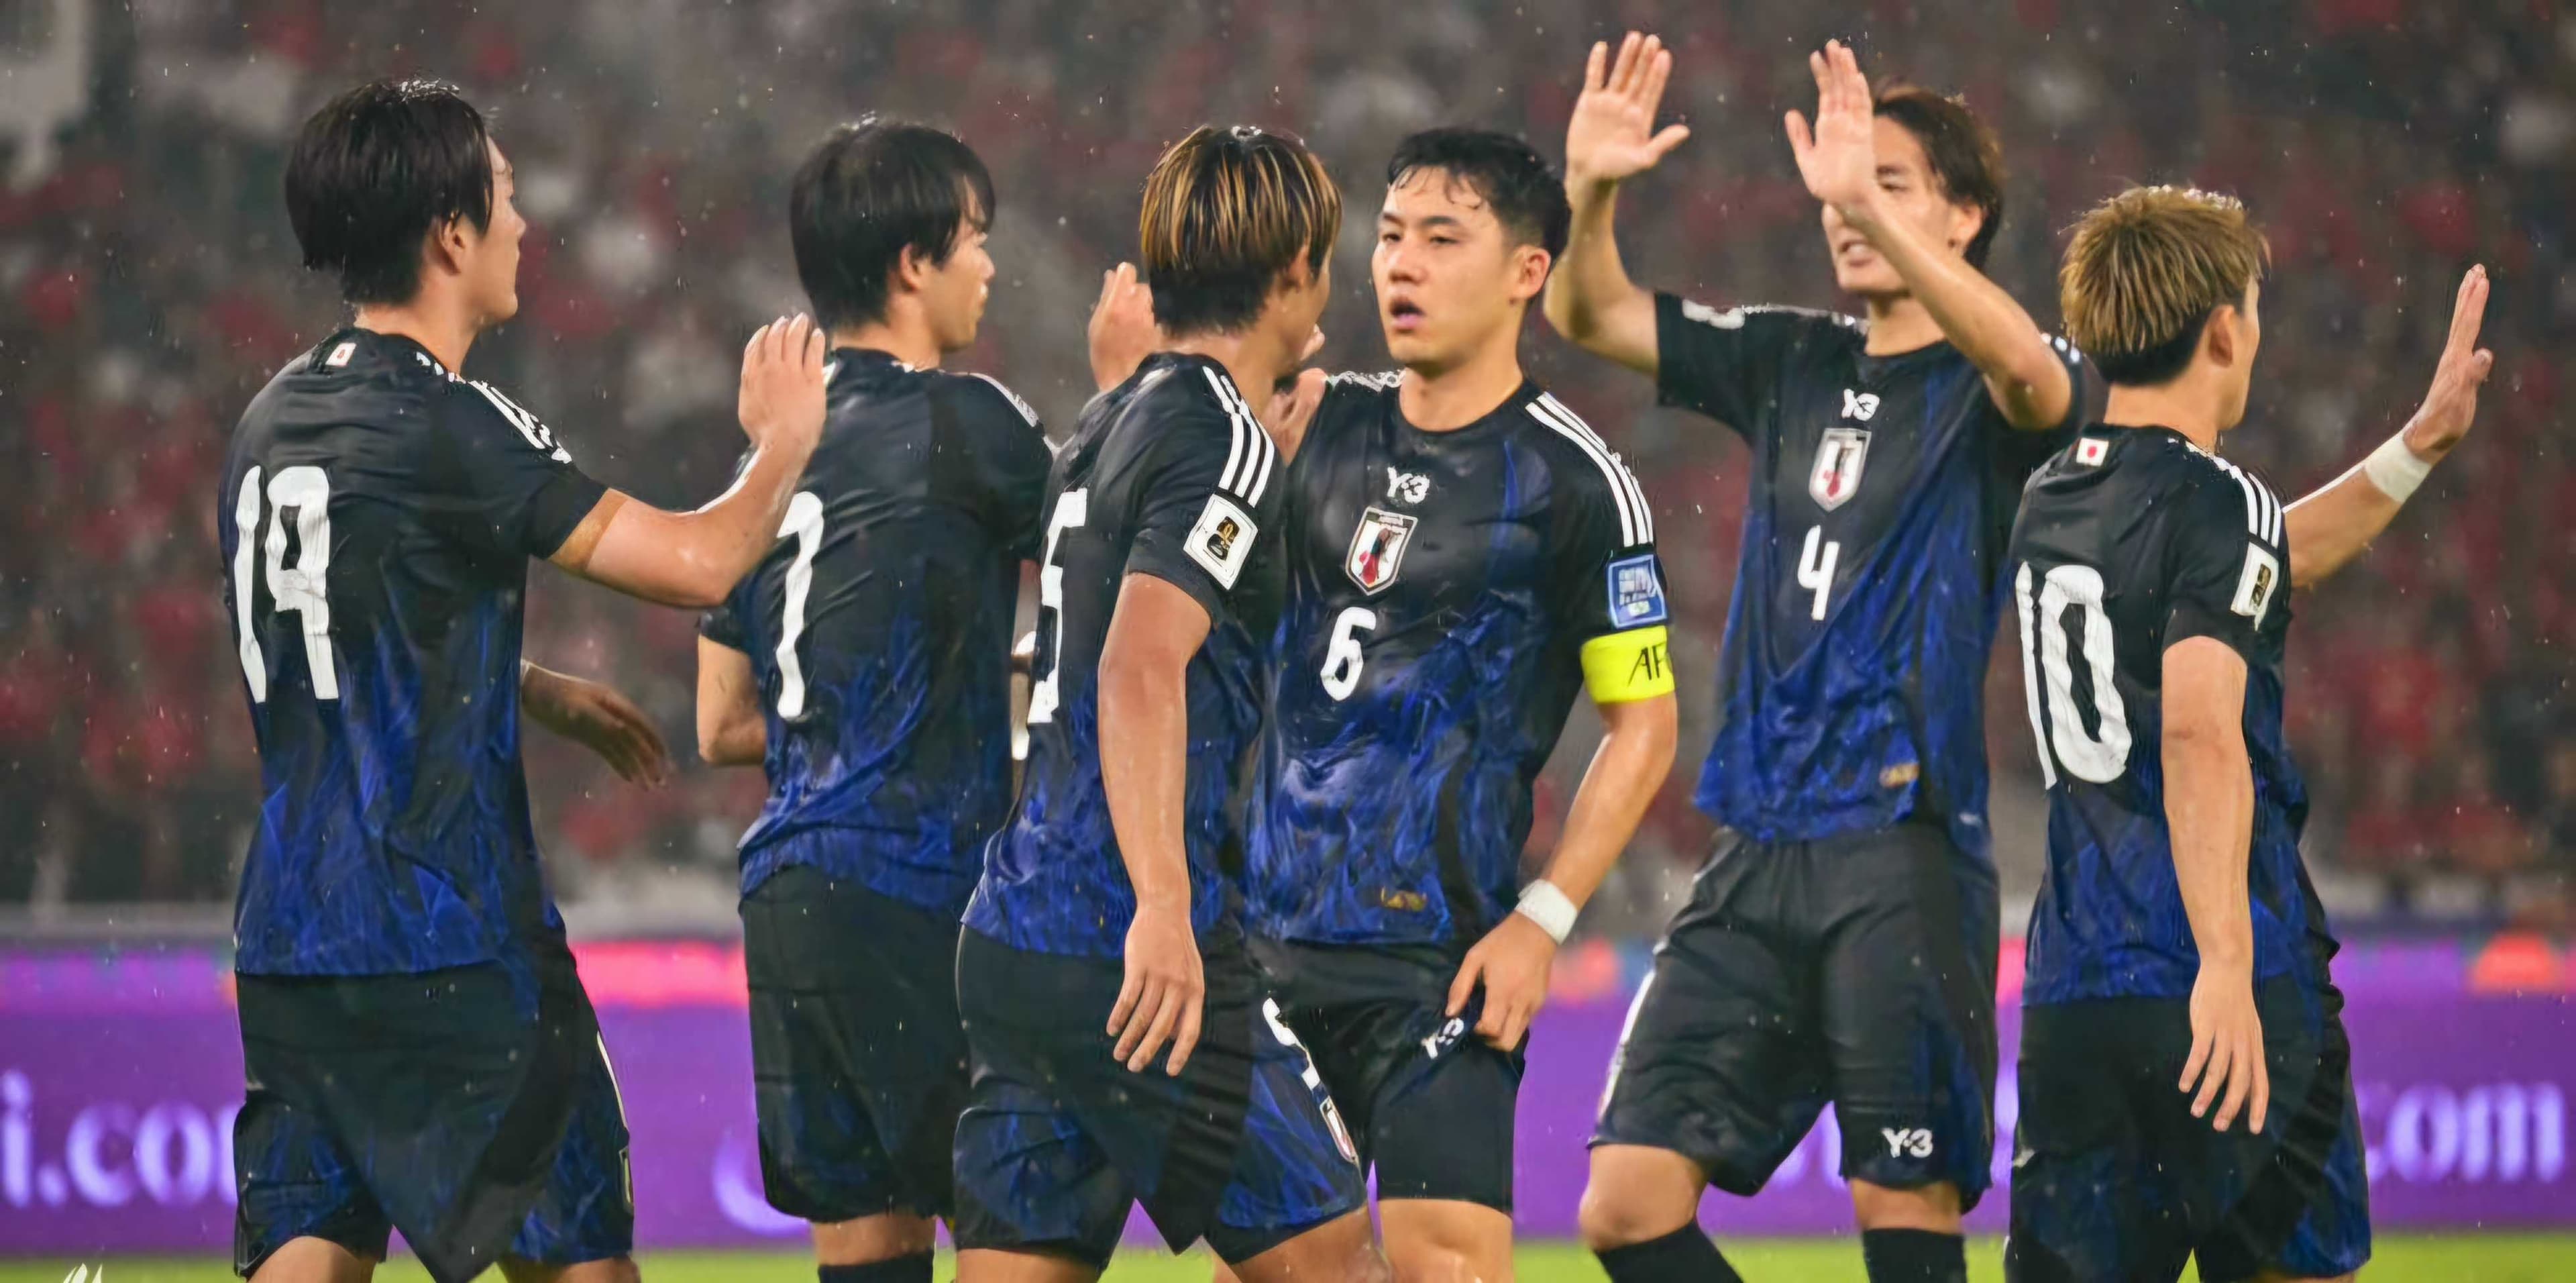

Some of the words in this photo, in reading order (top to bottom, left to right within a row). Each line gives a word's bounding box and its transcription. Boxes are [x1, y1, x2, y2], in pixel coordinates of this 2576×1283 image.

[234, 465, 339, 703] 19
[1798, 525, 1840, 620] 4
[1320, 607, 1377, 701] 6
[2015, 560, 2132, 790] 10
[1, 1070, 237, 1208] i.co
[1882, 1127, 1933, 1158] Y-3
